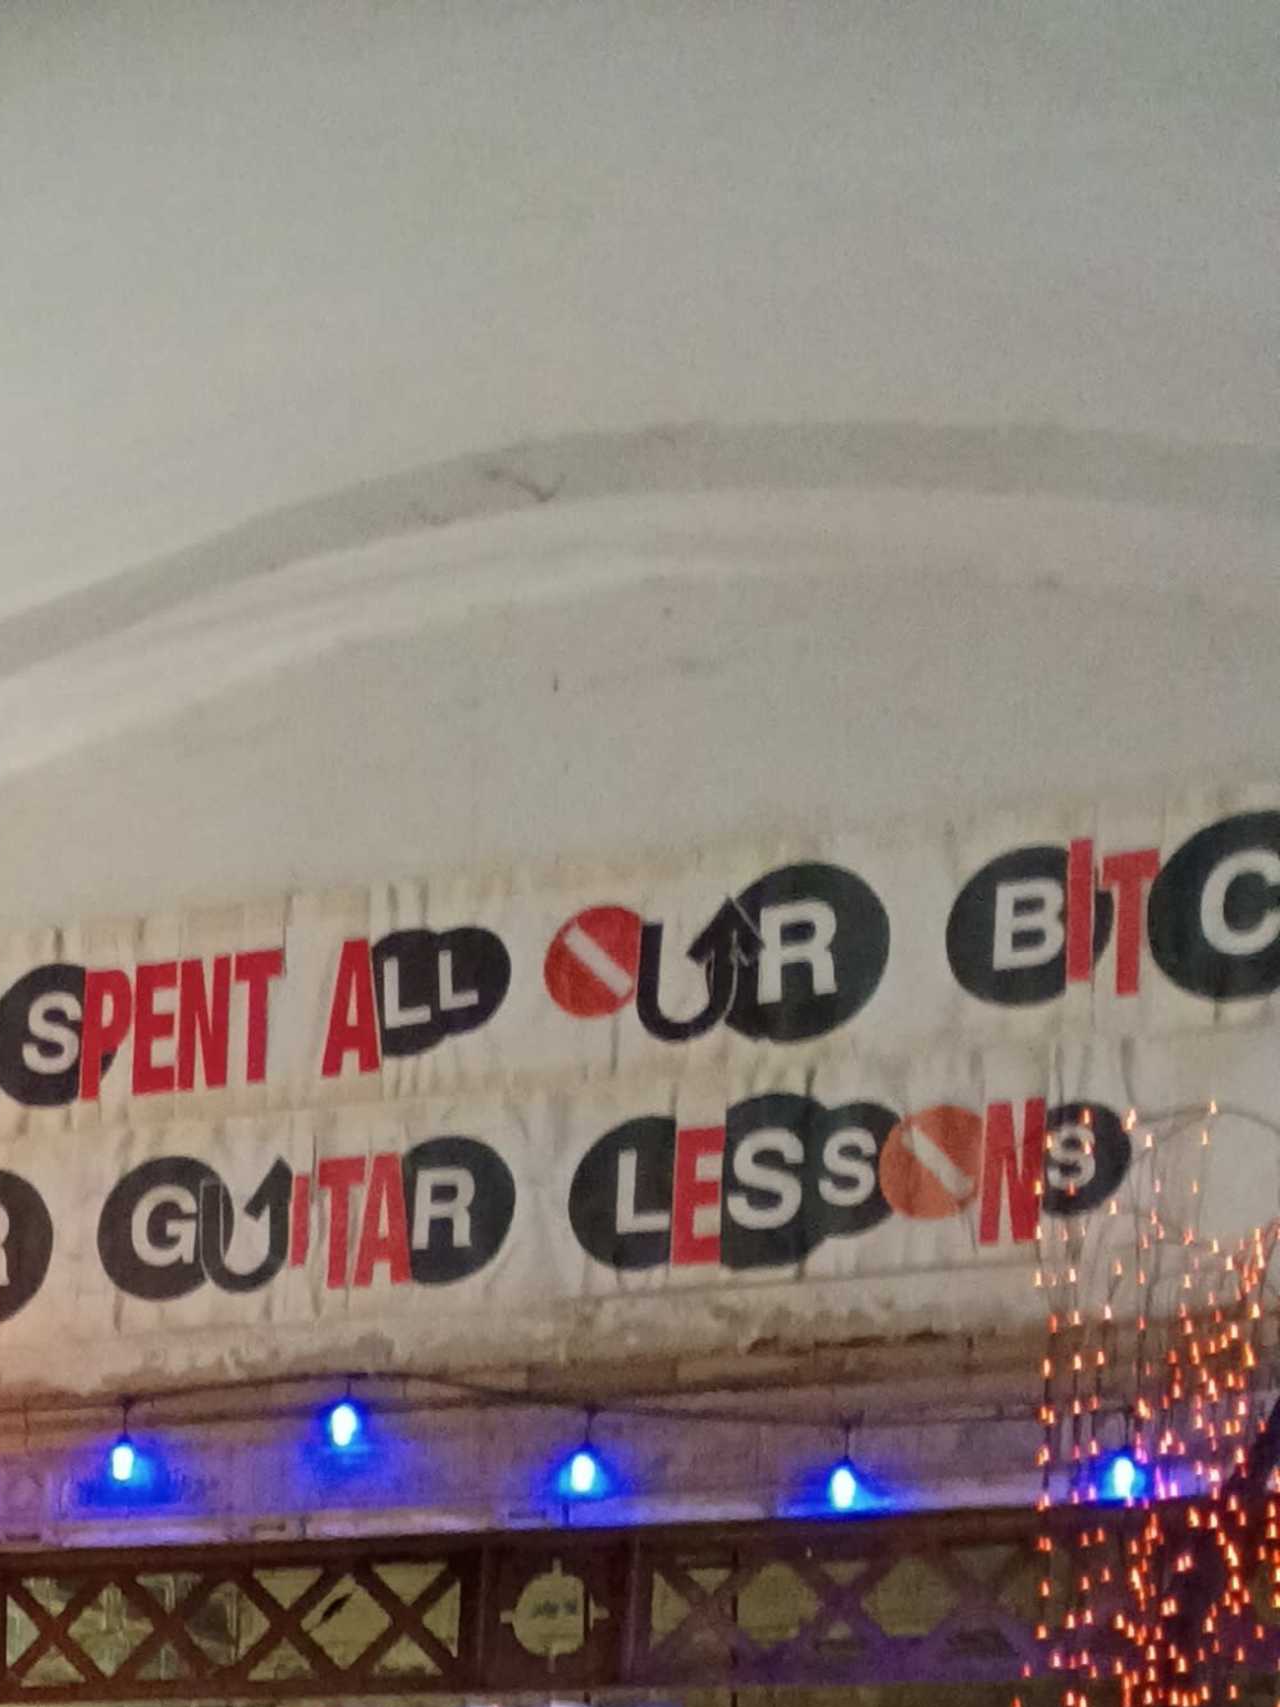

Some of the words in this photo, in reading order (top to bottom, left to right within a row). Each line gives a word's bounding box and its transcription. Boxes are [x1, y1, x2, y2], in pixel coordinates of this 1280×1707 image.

[0, 946, 286, 1108] SPENT
[320, 937, 495, 1078] ALL
[115, 1153, 485, 1290] GUITAR
